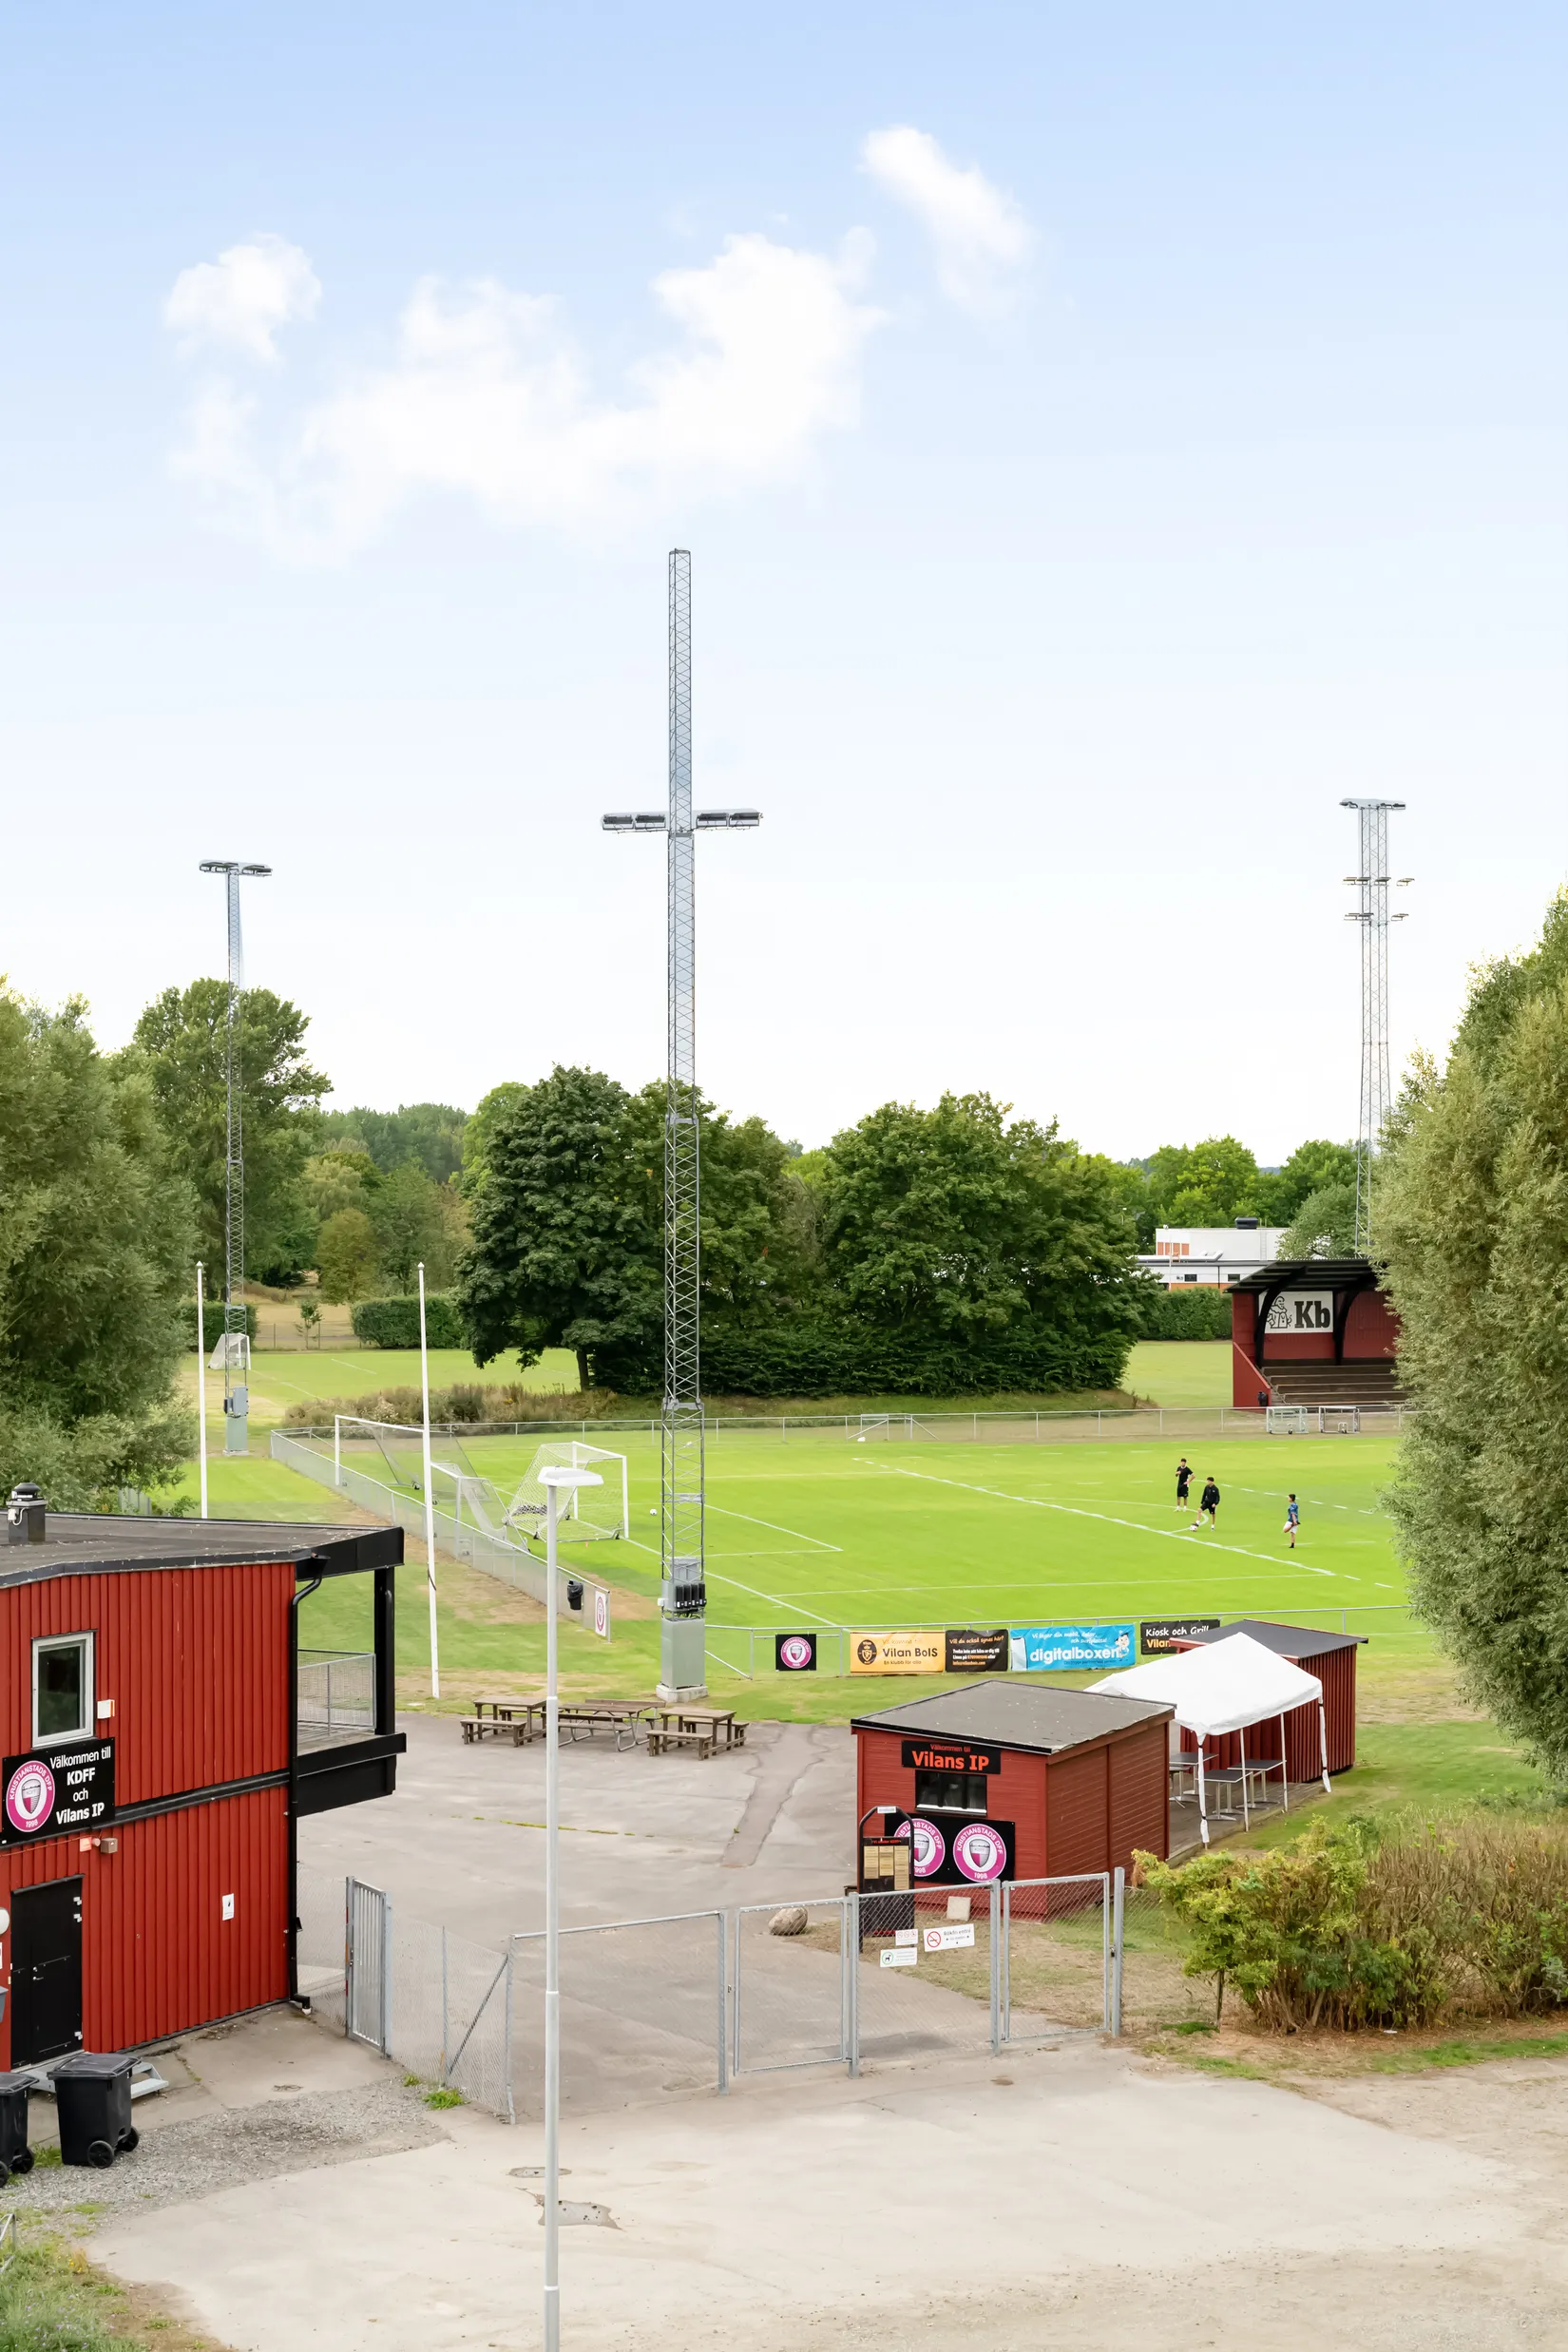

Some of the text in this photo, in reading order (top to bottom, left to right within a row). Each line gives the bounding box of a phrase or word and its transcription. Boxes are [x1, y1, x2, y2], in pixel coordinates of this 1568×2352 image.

[1294, 1301, 1330, 1328] Kb
[1145, 1626, 1209, 1636] Kiosk och Grill
[883, 1648, 911, 1657] Vilan
[1029, 1647, 1120, 1664] digitalboxen
[49, 1746, 111, 1769] Välkommen till
[912, 1750, 989, 1771] Vilans IP
[10, 1765, 47, 1800] KRISTIANSTADS
[67, 1768, 96, 1787] KDFF
[73, 1788, 88, 1802] och
[26, 1819, 38, 1828] 1998
[56, 1802, 105, 1825] Vilans IP
[898, 1822, 943, 1849] ISTINSTADS DFF
[956, 1826, 1004, 1854] KRISTIANSTADS DFF
